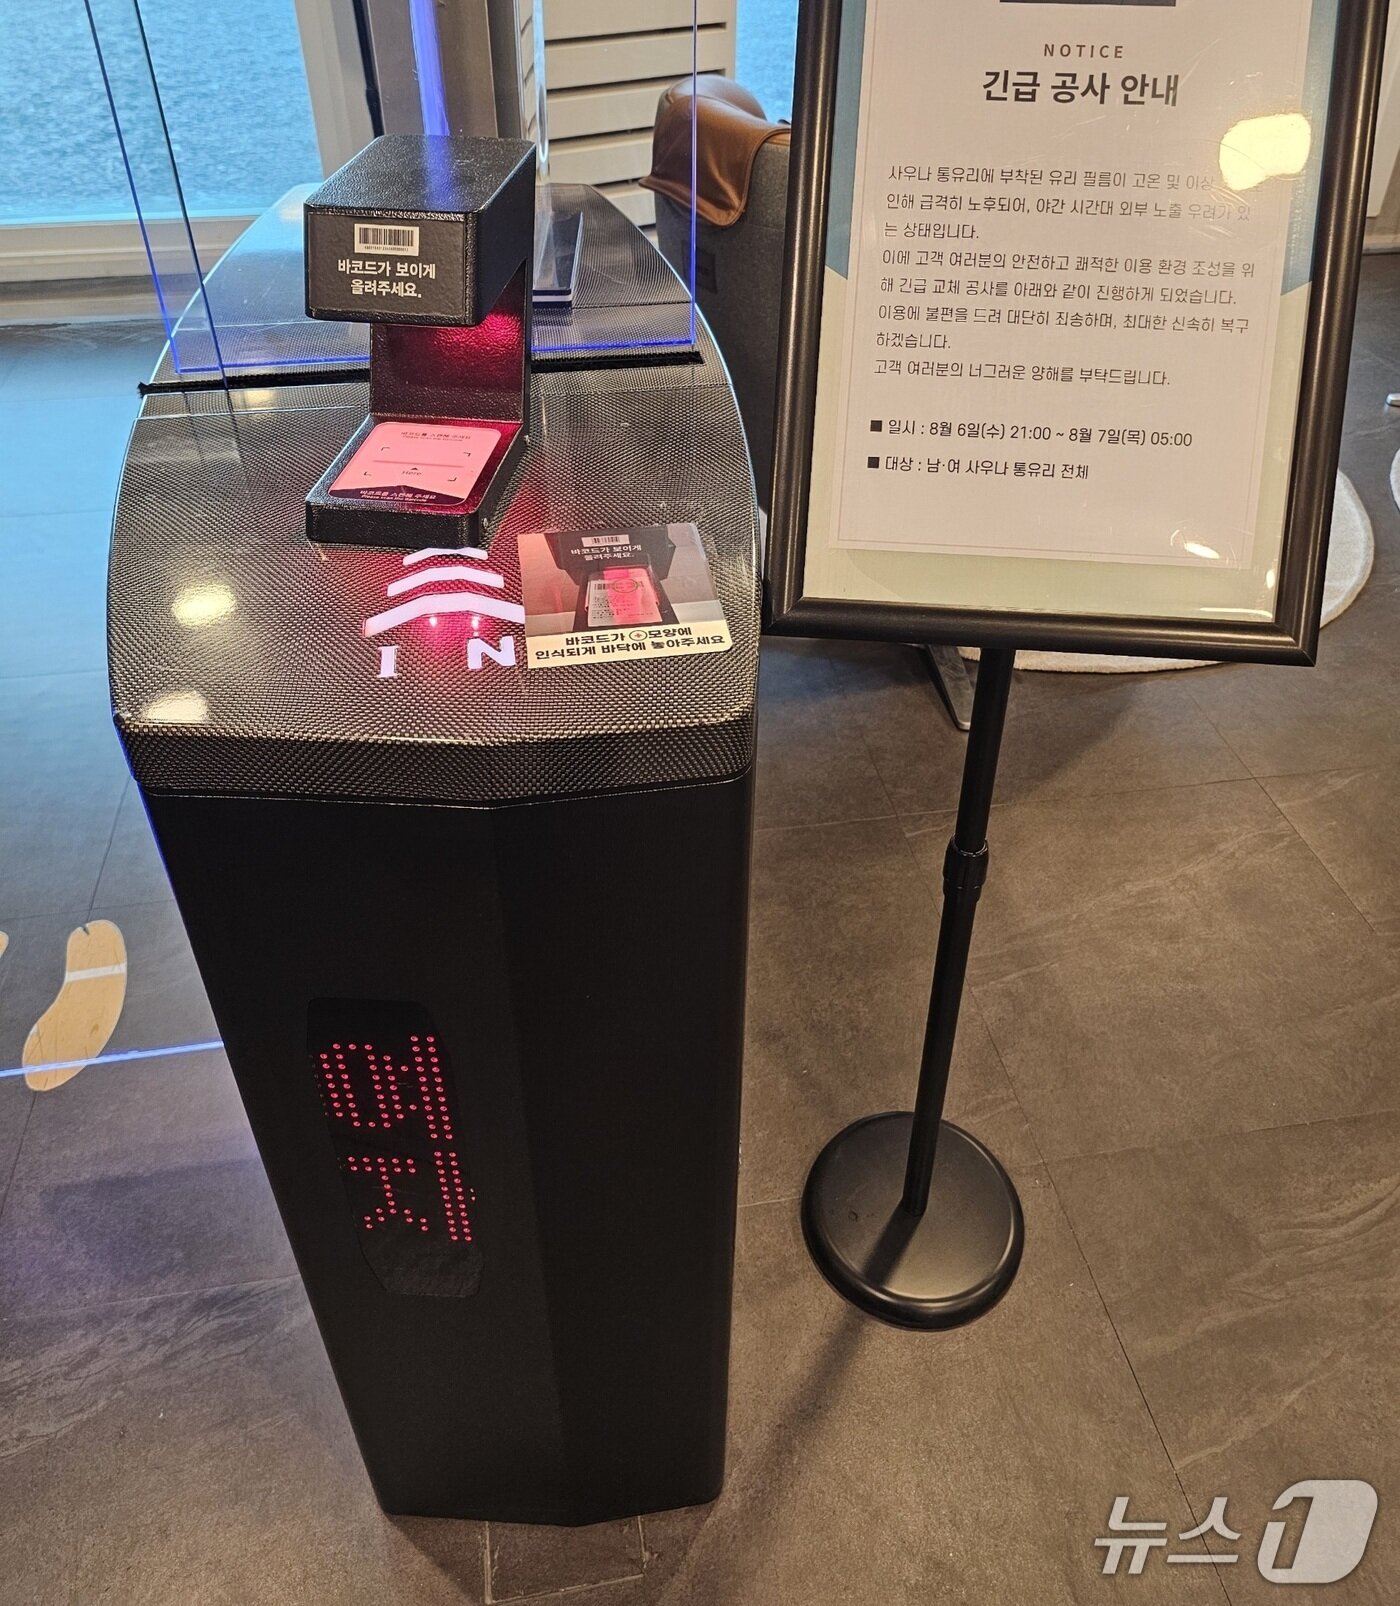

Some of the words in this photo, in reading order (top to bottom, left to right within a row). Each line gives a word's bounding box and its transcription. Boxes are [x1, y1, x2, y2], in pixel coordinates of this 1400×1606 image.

[1043, 43, 1125, 60] NOTICE
[982, 70, 1040, 102] 긴급
[1050, 72, 1111, 105] 공사
[1120, 74, 1179, 107] 안내
[888, 165, 932, 182] 사우나
[937, 166, 994, 183] 통유리에
[1000, 168, 1043, 185] 부착된
[1049, 170, 1077, 186] 유리
[1083, 171, 1126, 188] 필름이
[1132, 173, 1161, 189] 고온
[1167, 173, 1180, 190] 및
[886, 193, 914, 210] 인해
[920, 195, 962, 211] 급격히
[968, 196, 1030, 214] 노후되어,
[1036, 198, 1066, 214] 야간
[1070, 199, 1114, 215] 시간대
[1119, 201, 1148, 217] 외부
[1153, 202, 1182, 219] 노출
[1188, 203, 1231, 220] 우려가
[884, 222, 898, 238] 는
[903, 222, 980, 239] 상태입니다.
[338, 259, 391, 277] 바코드가
[395, 262, 436, 279] 보이게
[882, 250, 910, 265] 이에
[915, 250, 943, 267] 고객
[949, 252, 1006, 269] 여러분의
[1012, 253, 1069, 271] 안전하고
[1075, 256, 1119, 273] 쾌적한
[1124, 258, 1152, 275] 이용
[1158, 259, 1187, 276] 환경
[1192, 261, 1236, 278] 조성을
[1241, 263, 1255, 278] 위
[351, 279, 422, 298] 올려주세요.
[880, 277, 893, 293] 해
[899, 278, 927, 294] 긴급
[932, 279, 960, 295] 교체
[965, 280, 1008, 297] 공사를
[1014, 282, 1057, 299] 아래와
[1062, 283, 1091, 300] 같이
[1096, 285, 1154, 302] 진행하게
[1160, 287, 1236, 305] 되었습니다.
[879, 305, 920, 321] 이용에
[926, 306, 968, 323] 불편을
[973, 308, 1001, 324] 드려
[1007, 309, 1049, 326] 대단히
[1056, 311, 1117, 330] 죄송하며,
[1123, 314, 1167, 331] 최대한
[1172, 315, 1215, 332] 신속히
[1221, 318, 1249, 334] 복구
[876, 332, 951, 349] 하겠습니다.
[874, 359, 901, 375] 고객
[907, 360, 963, 377] 여러분의
[969, 363, 1025, 380] 너그러운
[1031, 365, 1074, 382] 양해를
[1079, 367, 1170, 386] 부탁드립니다.
[888, 419, 916, 435] 일시
[929, 422, 952, 437] 8월
[957, 422, 1005, 440] 6일(수)
[1010, 426, 1052, 440] 21:00
[1069, 427, 1092, 443] 8월
[1098, 428, 1146, 446] 7일(목)
[1150, 431, 1192, 447] 05:00
[885, 456, 914, 472] 대상
[965, 459, 1008, 475] 사우나
[1013, 462, 1055, 478] 통유리
[1061, 464, 1089, 480] 전체
[535, 646, 596, 660] 인식되게
[602, 642, 646, 653] 바닥에
[651, 635, 725, 650] 놓아주세요
[565, 633, 625, 647] 바코드가
